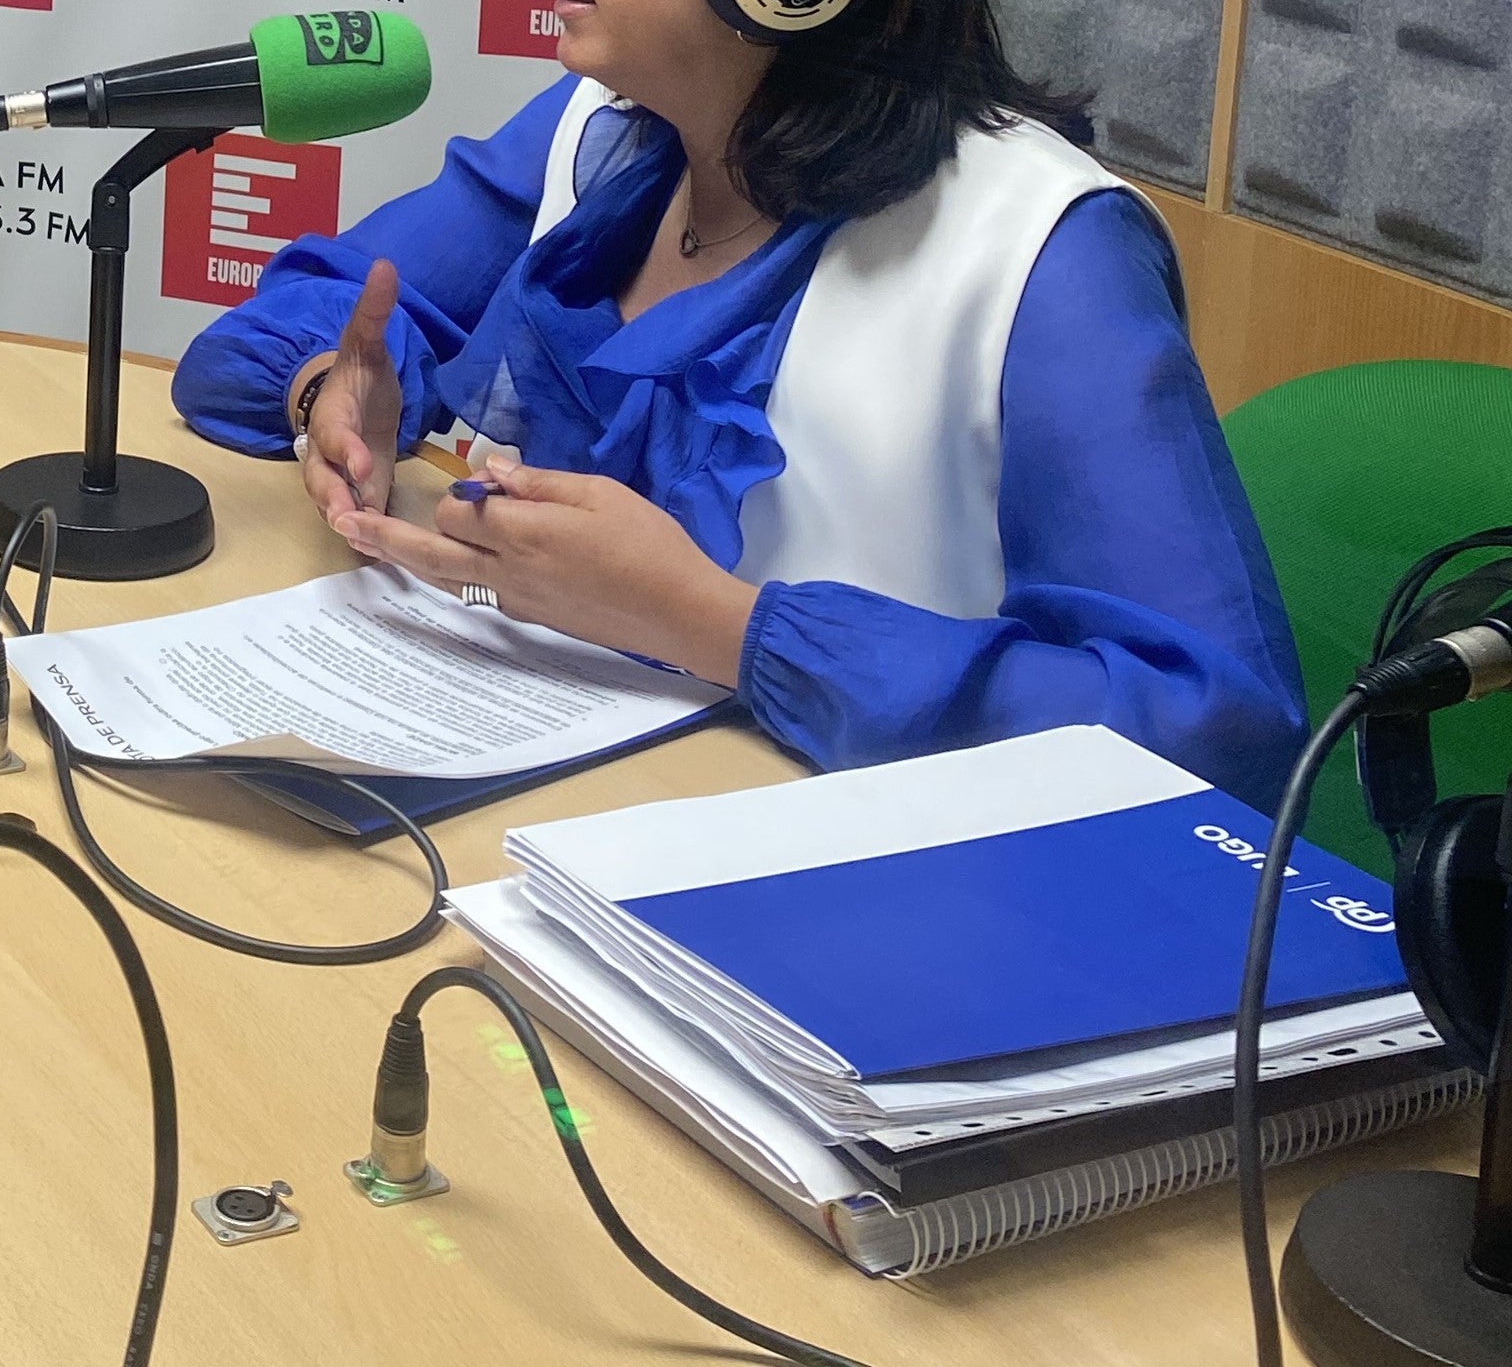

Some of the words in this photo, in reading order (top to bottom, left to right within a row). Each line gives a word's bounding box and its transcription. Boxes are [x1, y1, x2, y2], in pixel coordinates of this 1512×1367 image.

[17, 161, 65, 195] FM
[46, 211, 91, 246] FM
[207, 256, 265, 289] EUROP
[46, 663, 105, 727] PRENSA
[96, 726, 126, 746] DE
